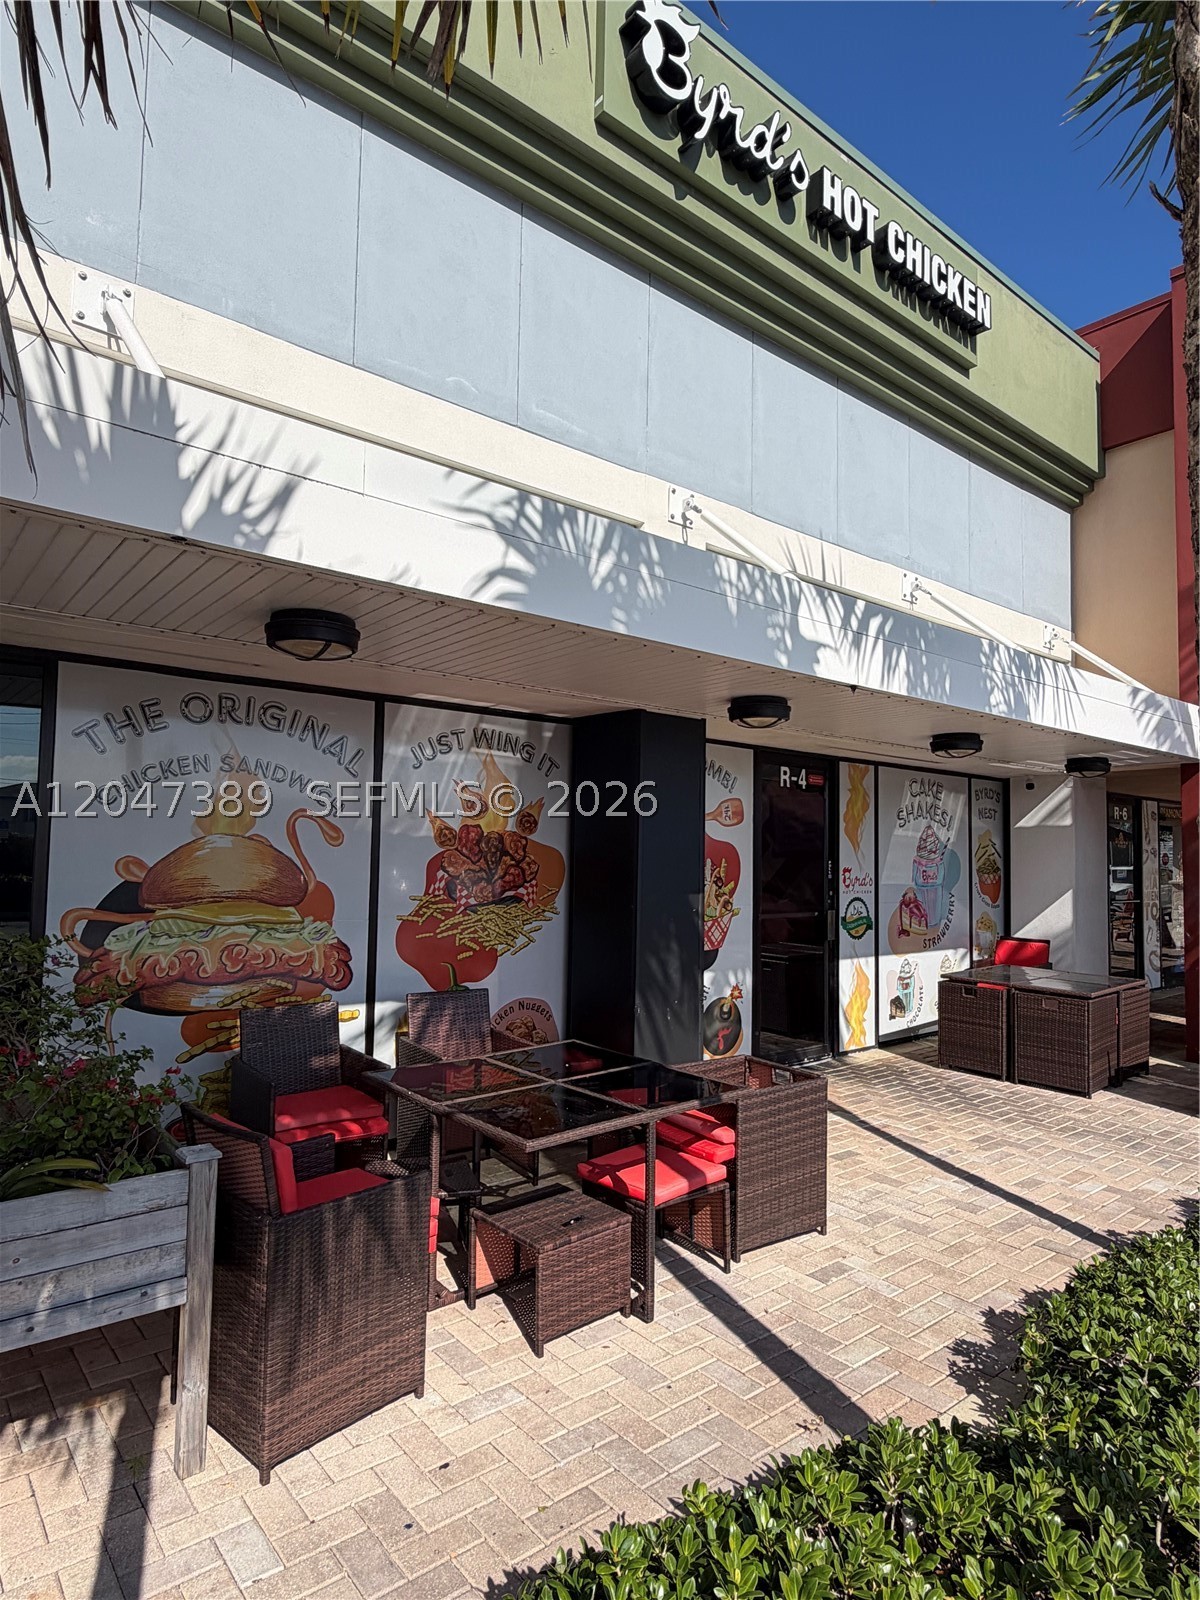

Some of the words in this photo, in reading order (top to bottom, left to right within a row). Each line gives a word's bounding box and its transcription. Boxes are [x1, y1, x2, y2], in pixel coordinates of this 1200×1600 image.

[634, 0, 810, 191] Byrd's
[822, 166, 880, 244] HOT
[887, 221, 992, 330] CHICKEN
[72, 697, 170, 755] THE
[179, 691, 364, 778] ORIGINAL
[411, 728, 466, 769] JUST
[473, 727, 536, 763] WING
[537, 752, 560, 777] IT
[95, 754, 211, 806] CHICKEN
[219, 754, 346, 818] SANDWICH
[704, 759, 738, 794] MB!
[780, 766, 807, 790] R-4
[908, 777, 944, 802] CAKE
[974, 786, 1001, 804] BYRD'S
[896, 800, 954, 832] SHAKES!
[977, 806, 998, 821] NEST
[1113, 806, 1128, 821] R-6
[842, 867, 874, 891] Byrd's
[923, 892, 955, 949] STRAWBERRY
[490, 1005, 515, 1030] icken
[518, 1000, 554, 1022] Nuggets
[906, 985, 924, 1028] CHOCOLATE
